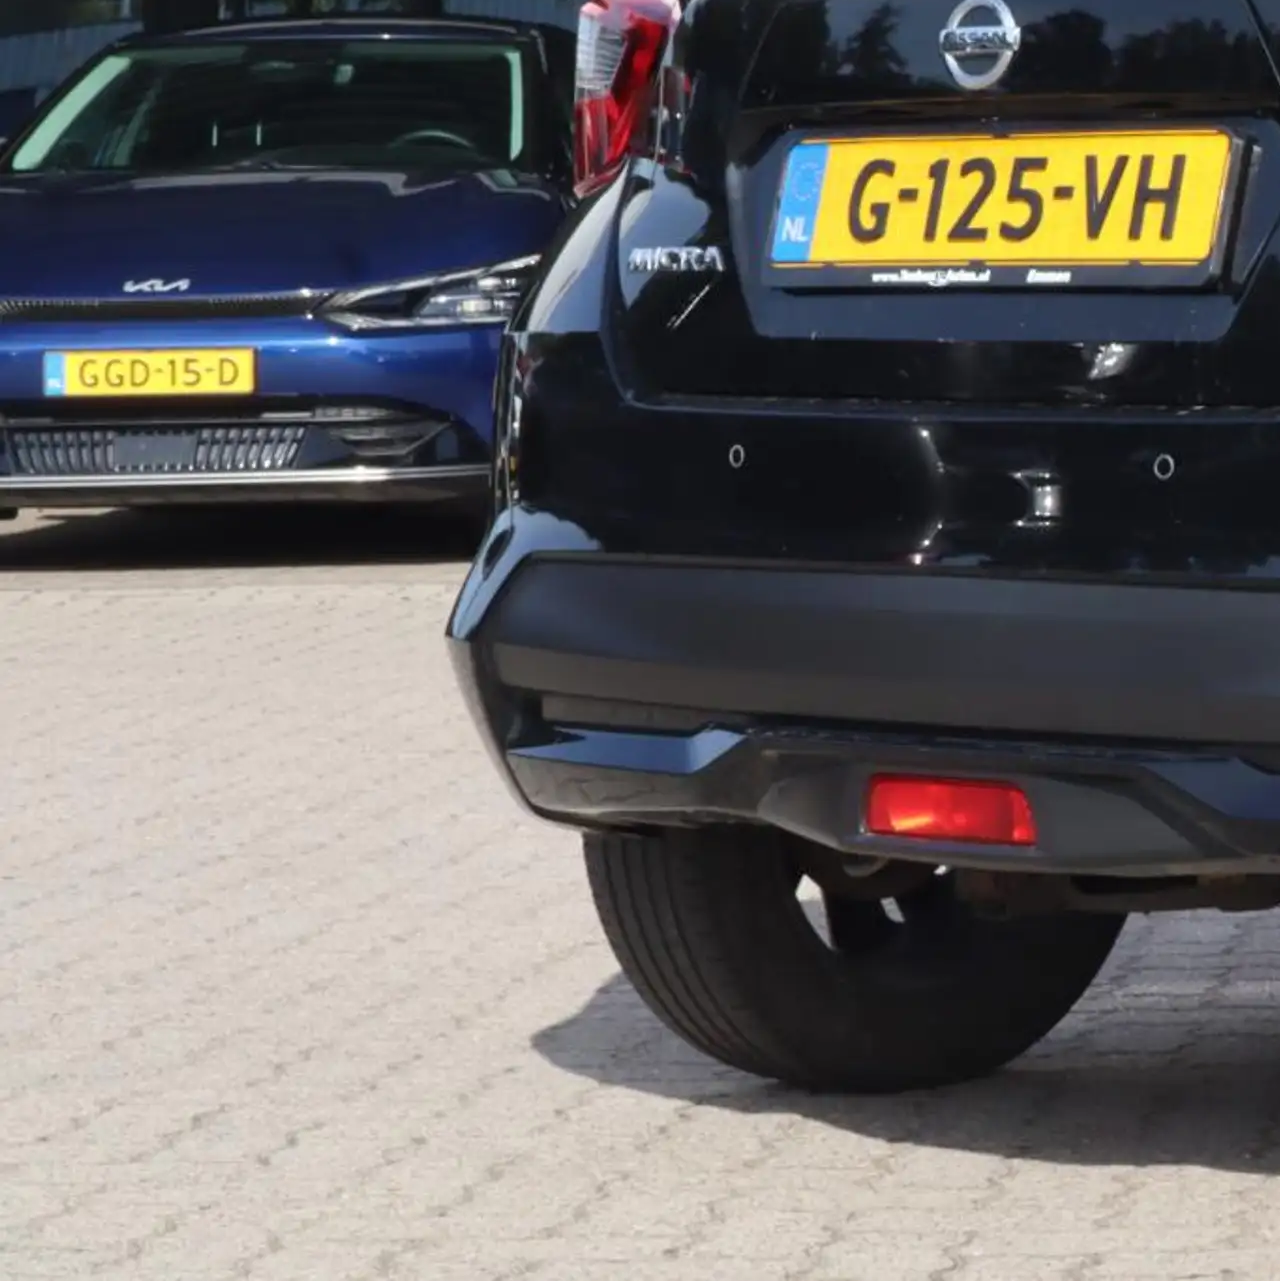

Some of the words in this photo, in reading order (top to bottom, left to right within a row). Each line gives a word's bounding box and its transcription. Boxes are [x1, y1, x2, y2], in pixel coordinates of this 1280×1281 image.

[847, 153, 1187, 245] G-125-VH
[781, 216, 808, 242] NL
[78, 357, 241, 389] GGD-15-D
